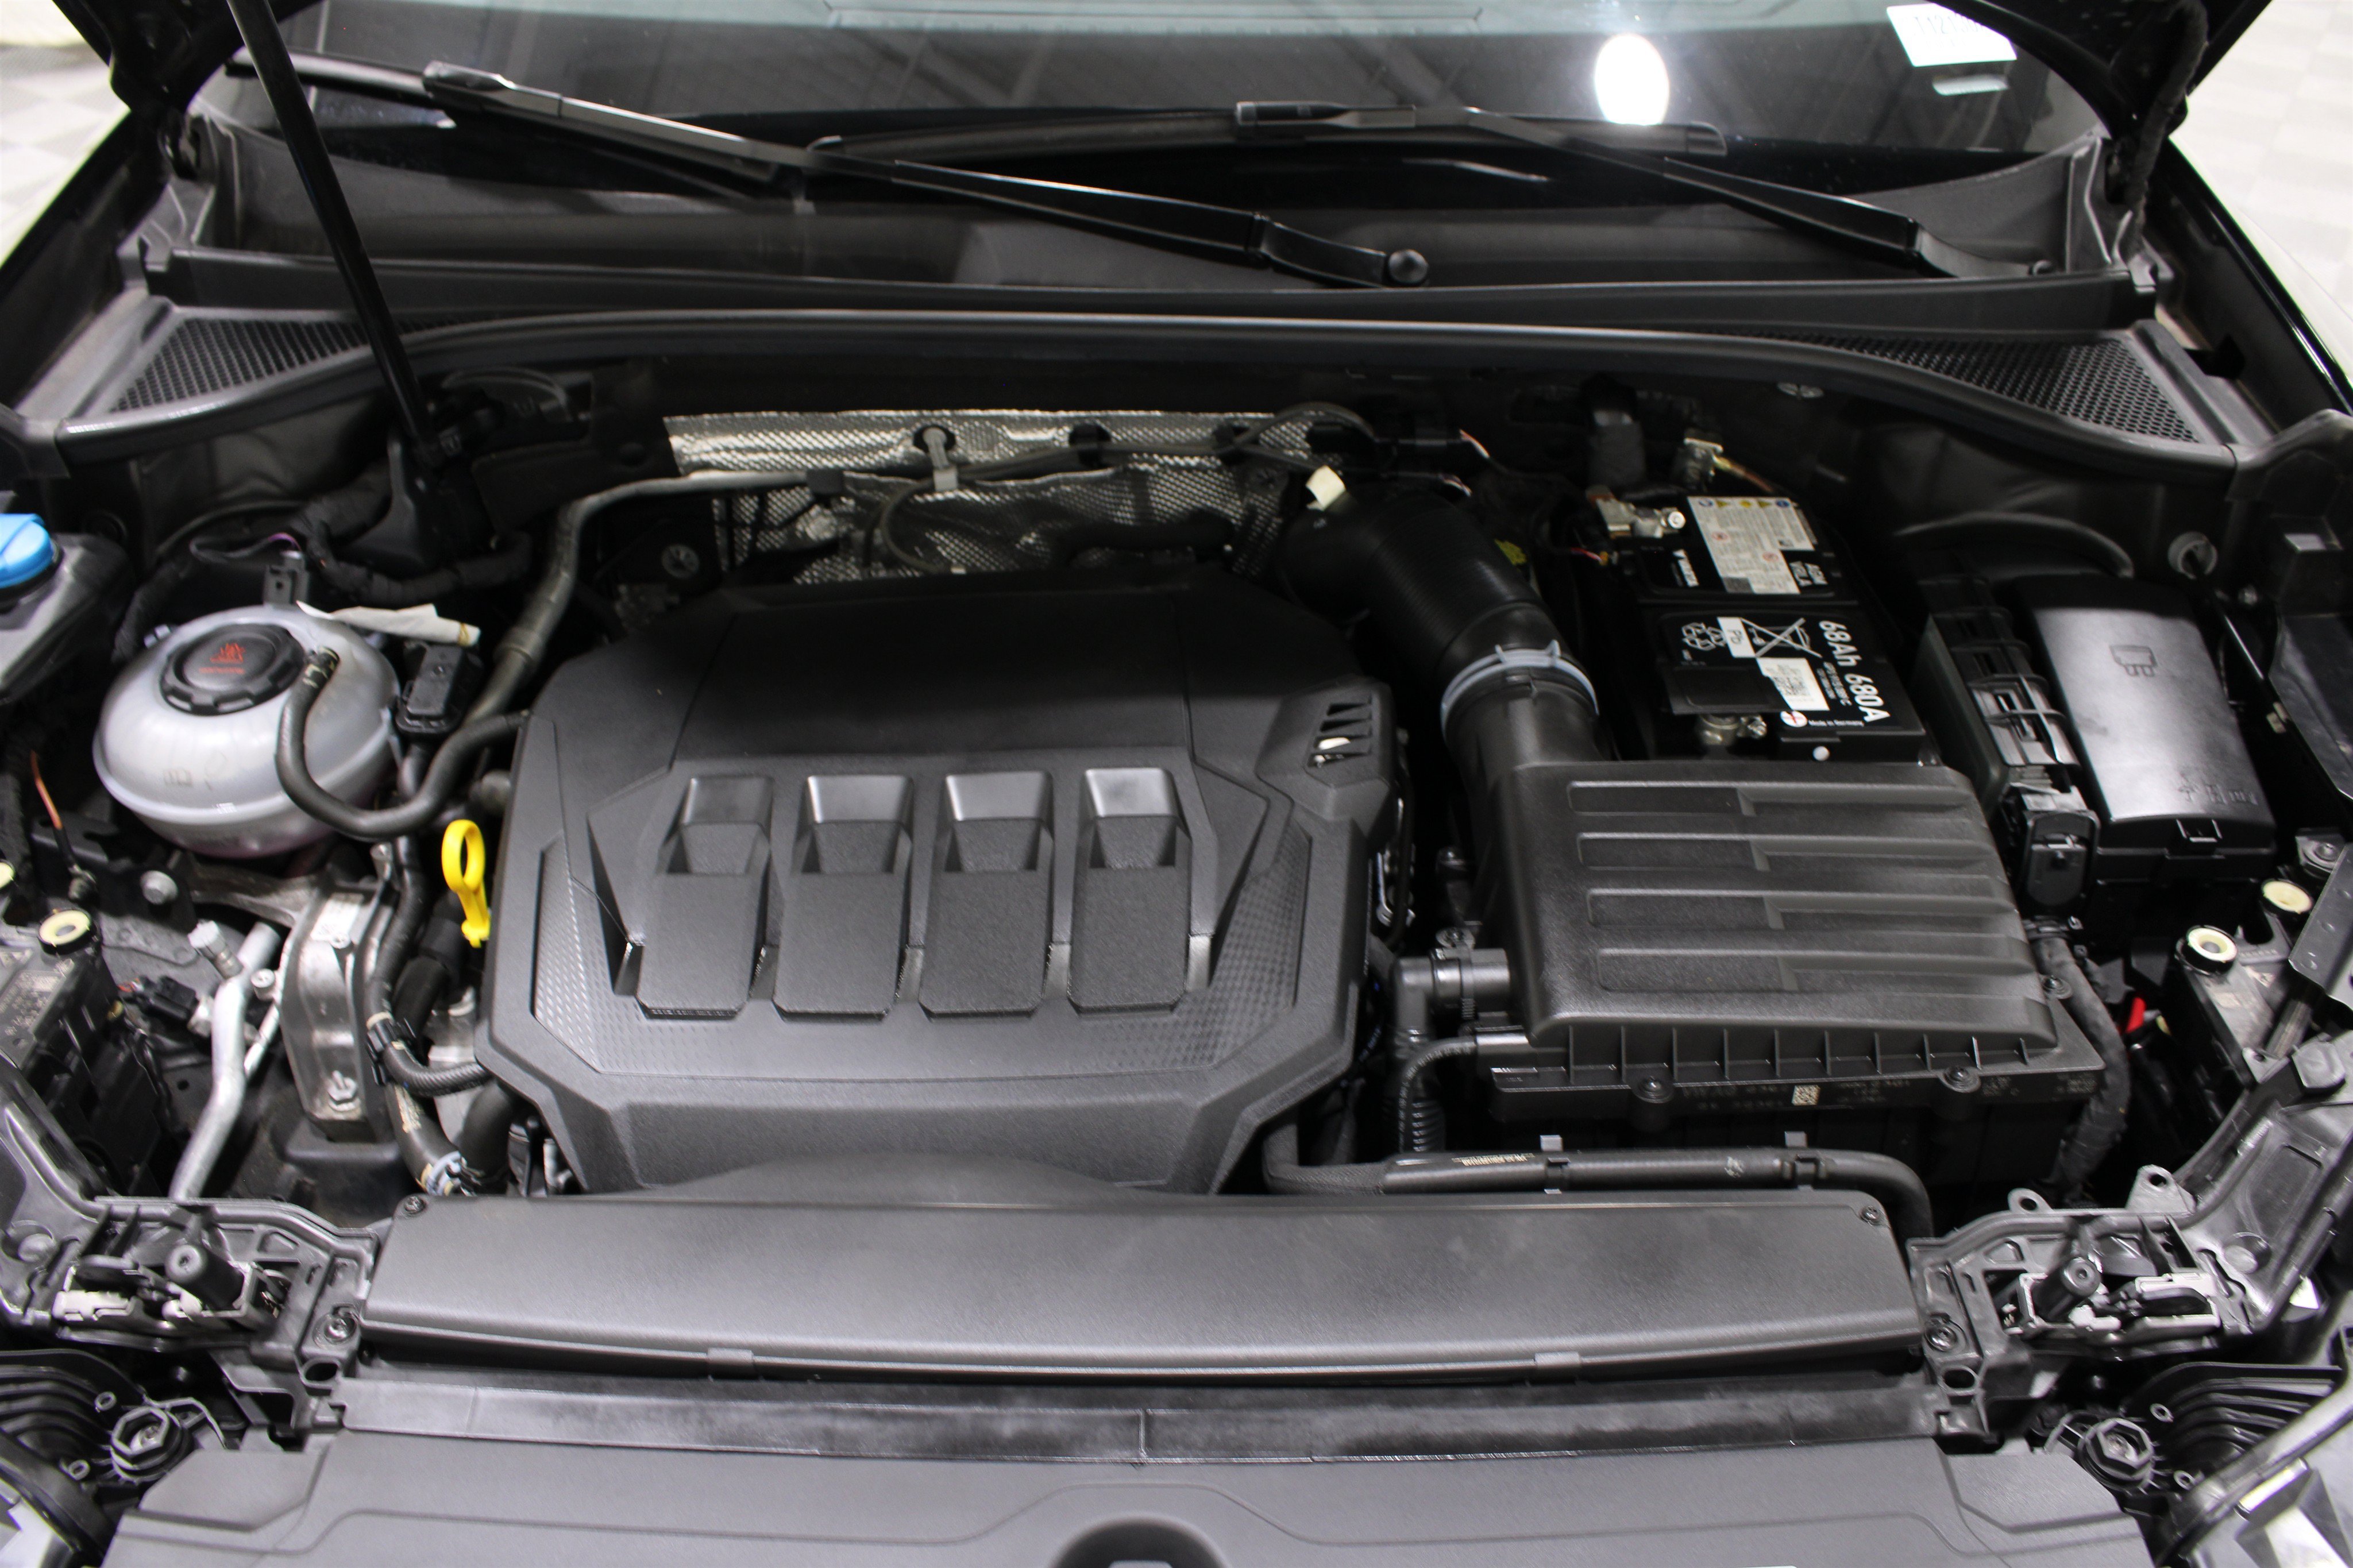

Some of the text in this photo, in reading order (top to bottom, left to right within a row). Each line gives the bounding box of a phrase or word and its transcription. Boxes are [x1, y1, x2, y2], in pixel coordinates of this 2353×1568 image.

[1727, 629, 1743, 644] Pb
[1819, 620, 1862, 666] 68Ah
[1844, 673, 1891, 722] 680A
